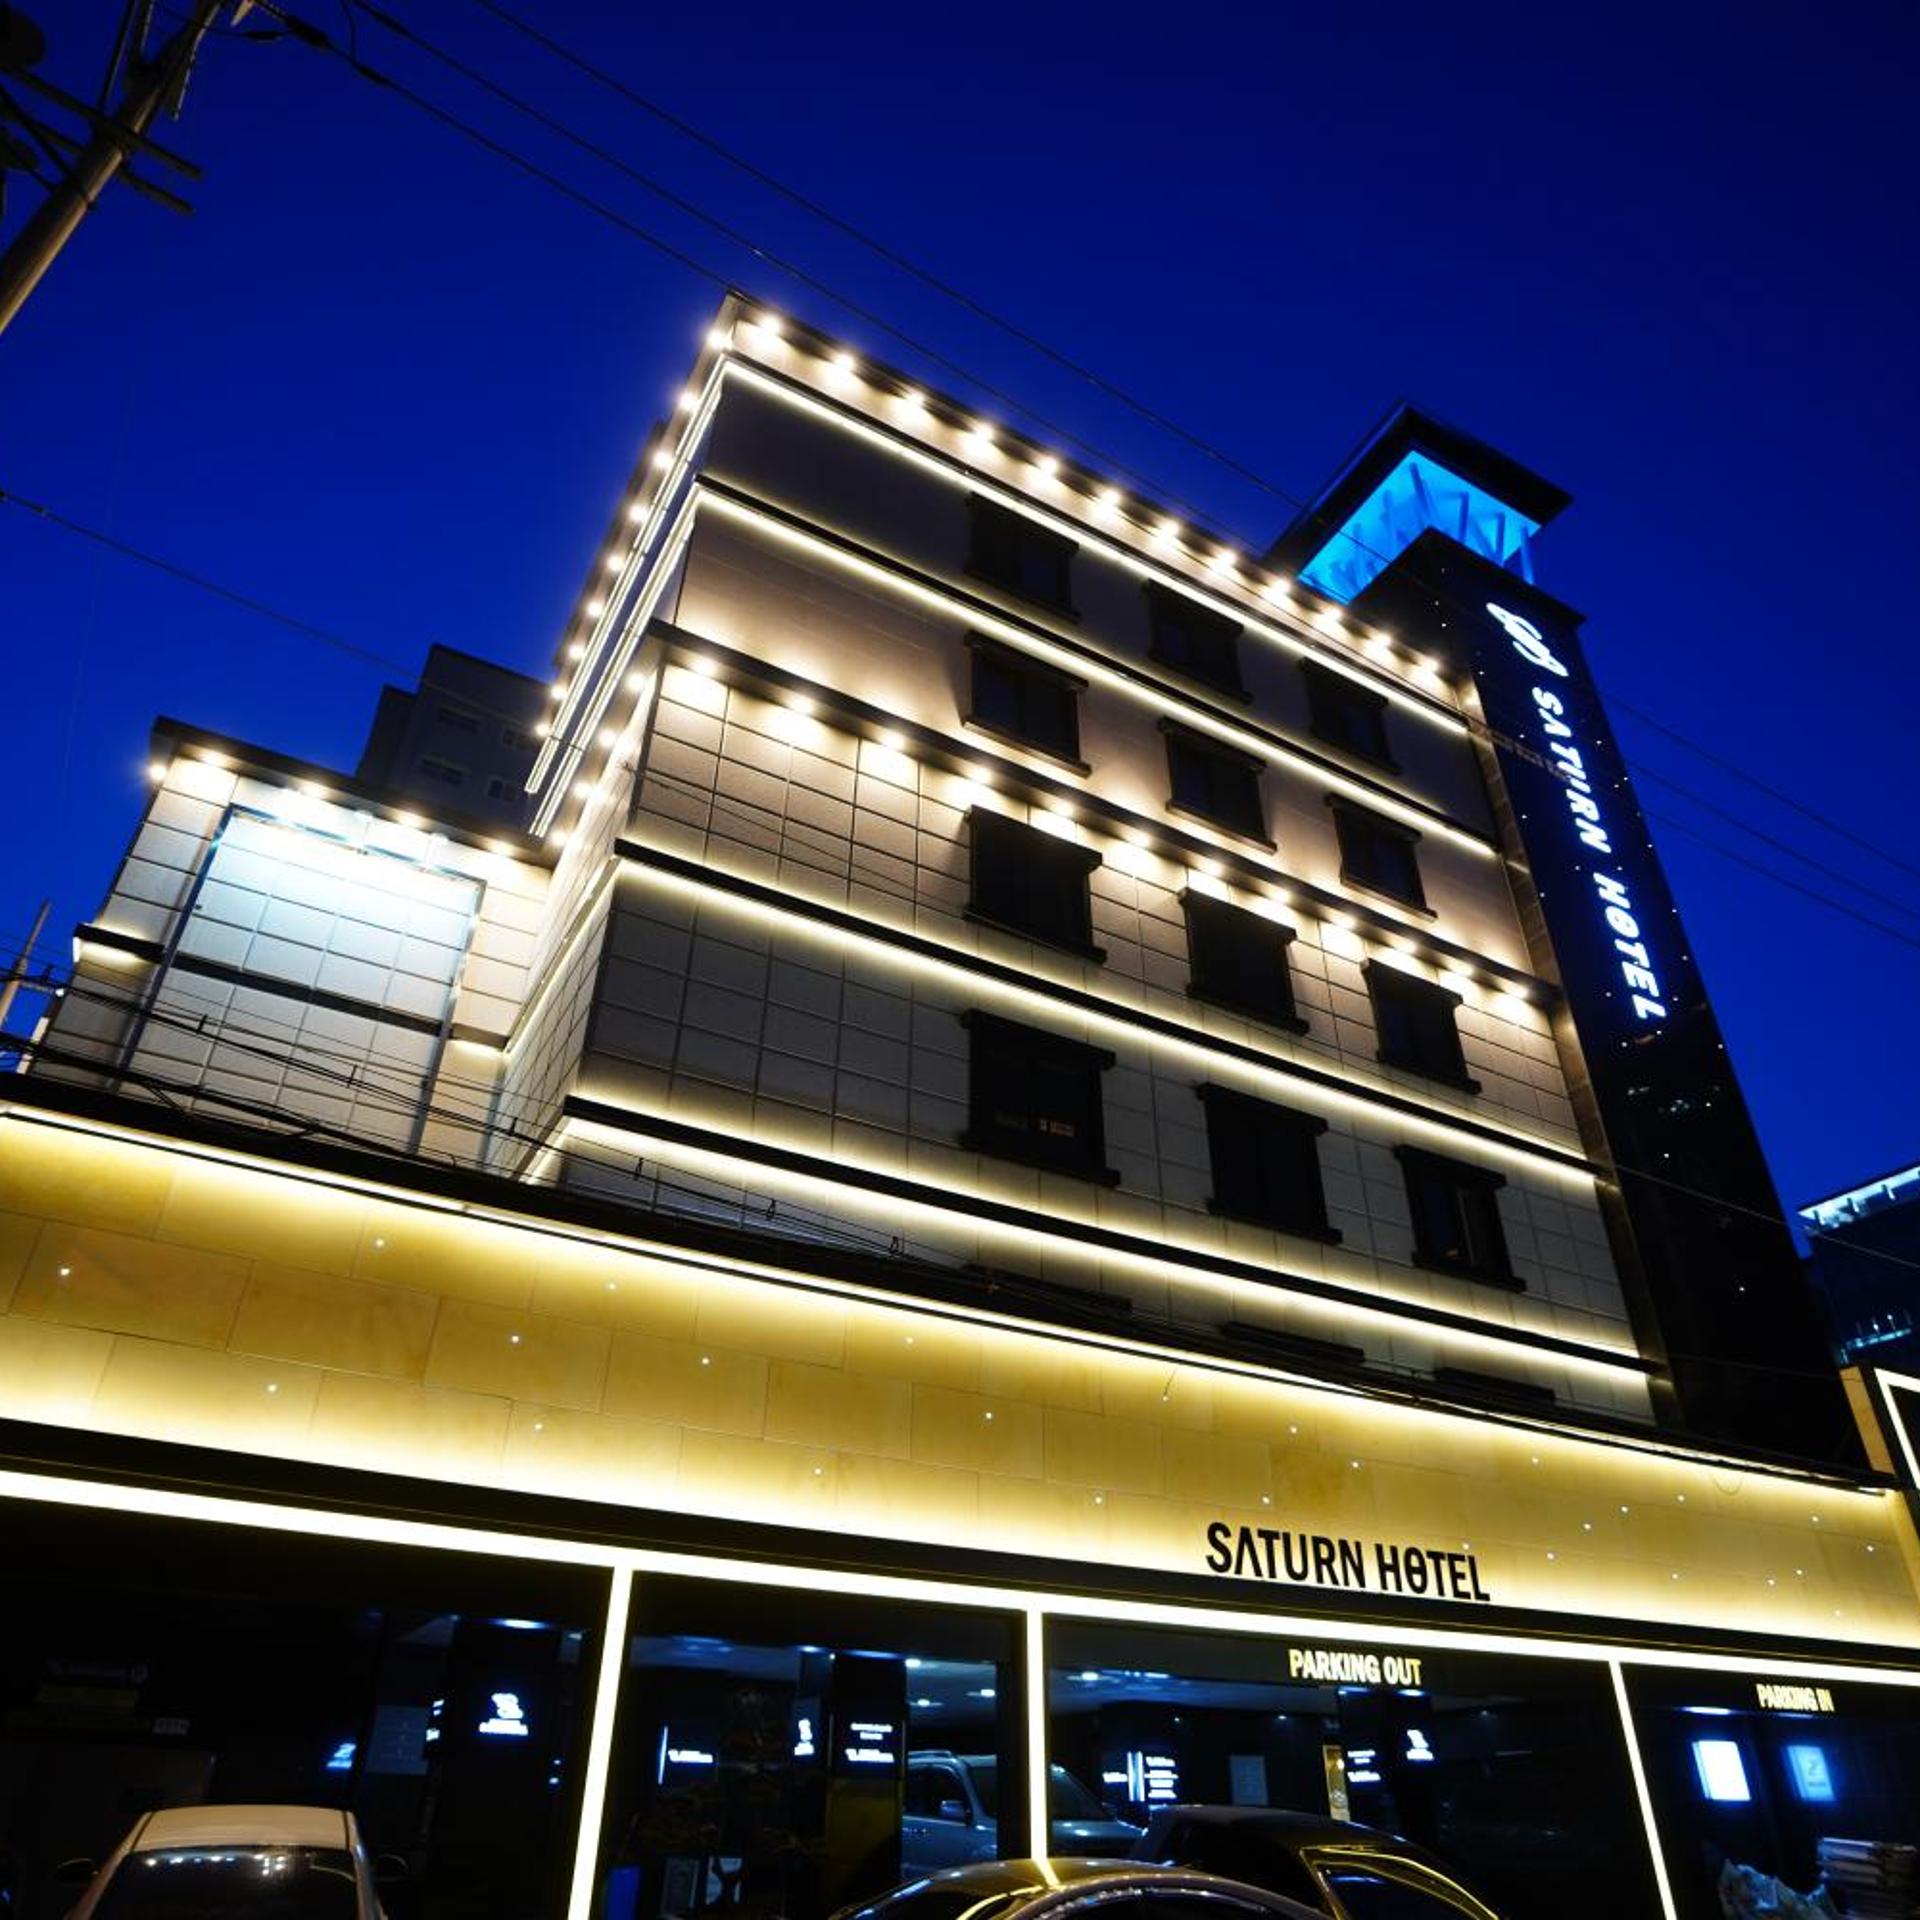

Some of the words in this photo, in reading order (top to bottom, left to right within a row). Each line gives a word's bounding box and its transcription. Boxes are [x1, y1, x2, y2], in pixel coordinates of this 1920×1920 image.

[1532, 685, 1612, 855] SATURN
[1593, 871, 1667, 1021] HOTEL
[1206, 1521, 1366, 1588] SATURN
[1374, 1543, 1491, 1602] HOTEL
[1289, 1649, 1381, 1684] PARKING
[1383, 1655, 1422, 1686] OUT
[1756, 1683, 1819, 1711] PARKING
[1816, 1688, 1834, 1711] IN
